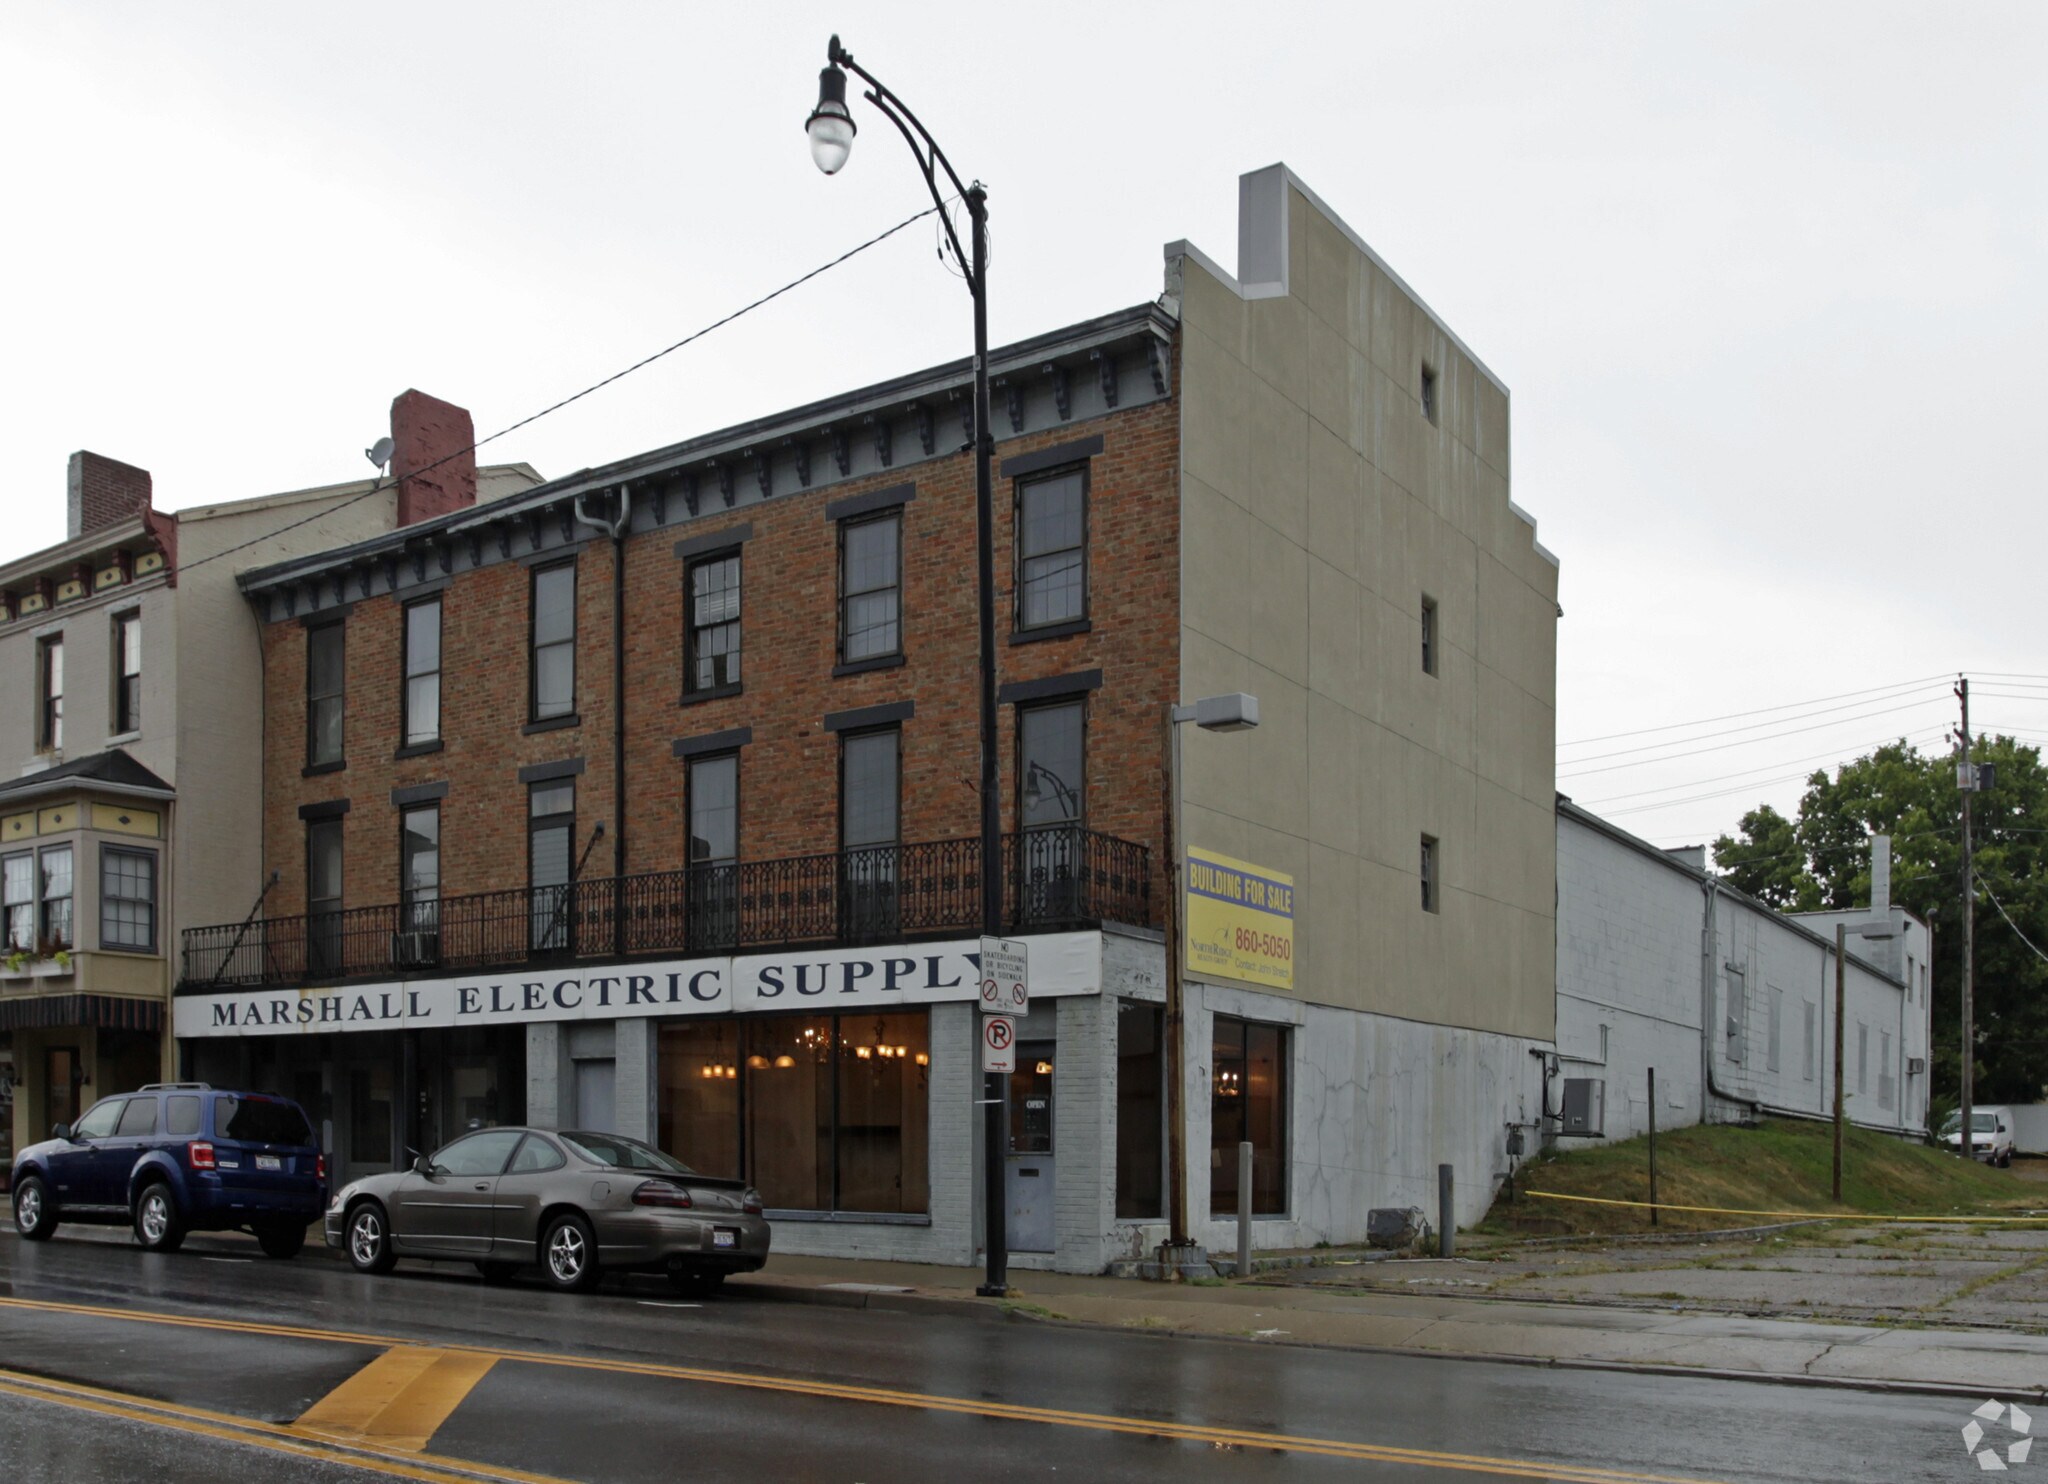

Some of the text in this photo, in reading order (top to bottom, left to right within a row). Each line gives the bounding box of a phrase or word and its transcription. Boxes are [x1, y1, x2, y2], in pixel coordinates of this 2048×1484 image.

[1190, 863, 1291, 913] BUILDING FOR SALE
[1000, 942, 1009, 953] NO
[1235, 927, 1290, 960] 860-5050
[983, 950, 1025, 964] SKATEBOARDING
[985, 960, 1023, 973] OR BICYCLING
[986, 969, 1022, 982] ON SIDEWALK
[212, 991, 432, 1027] MARSHALL
[457, 970, 722, 1015] ELECTRIC
